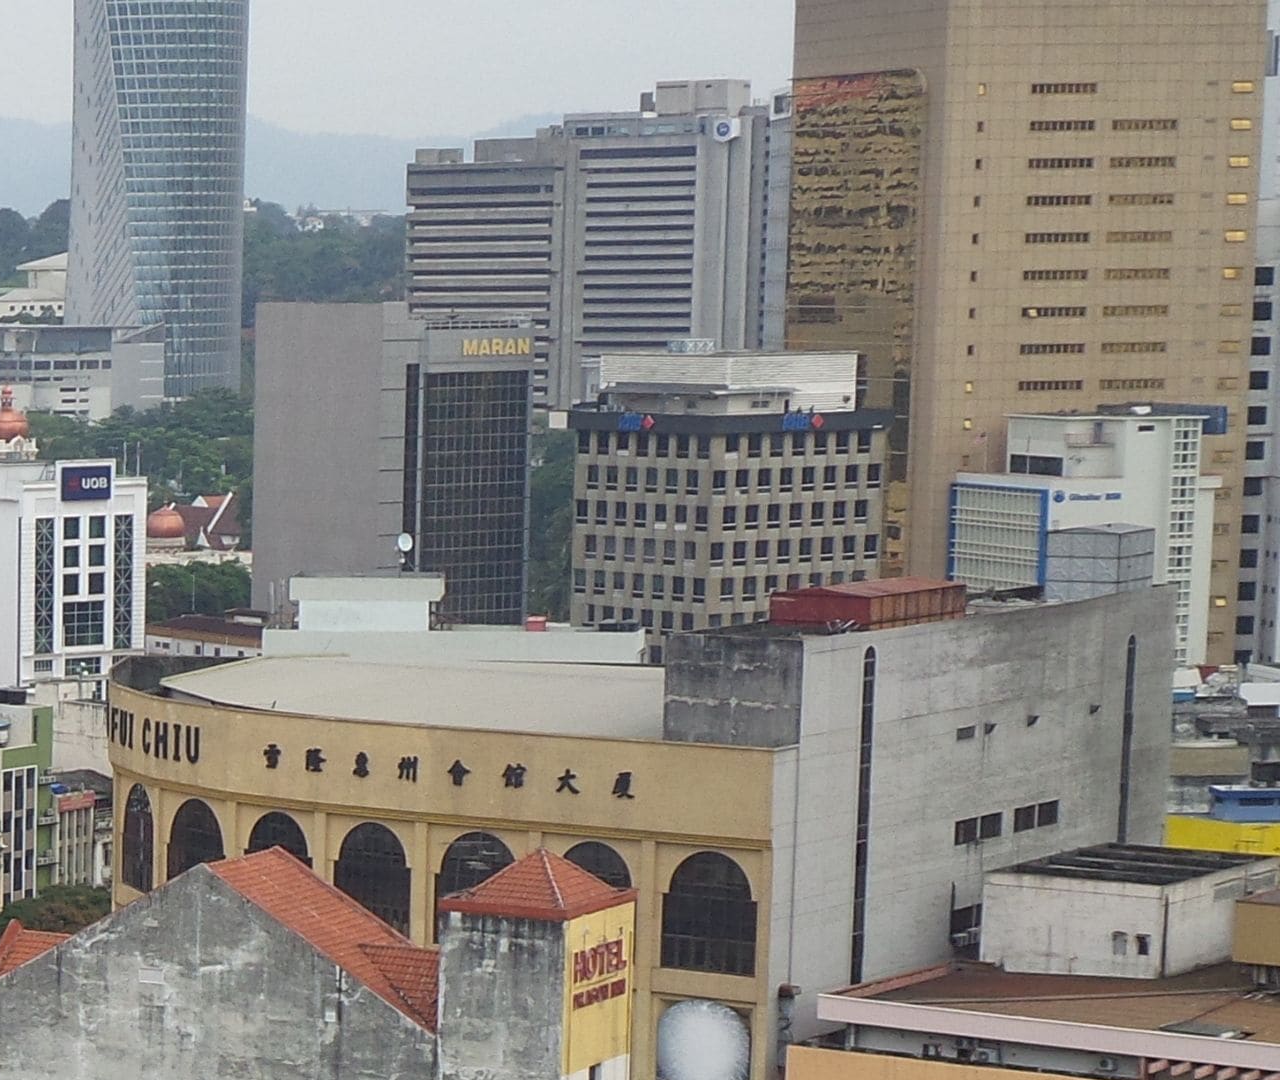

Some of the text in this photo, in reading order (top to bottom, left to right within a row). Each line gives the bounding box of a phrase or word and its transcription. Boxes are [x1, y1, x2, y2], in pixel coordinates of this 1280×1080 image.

[463, 337, 530, 356] MARAN
[81, 476, 108, 489] UOB
[111, 706, 201, 765] FUI CHIU
[573, 939, 627, 984] HOTEL
